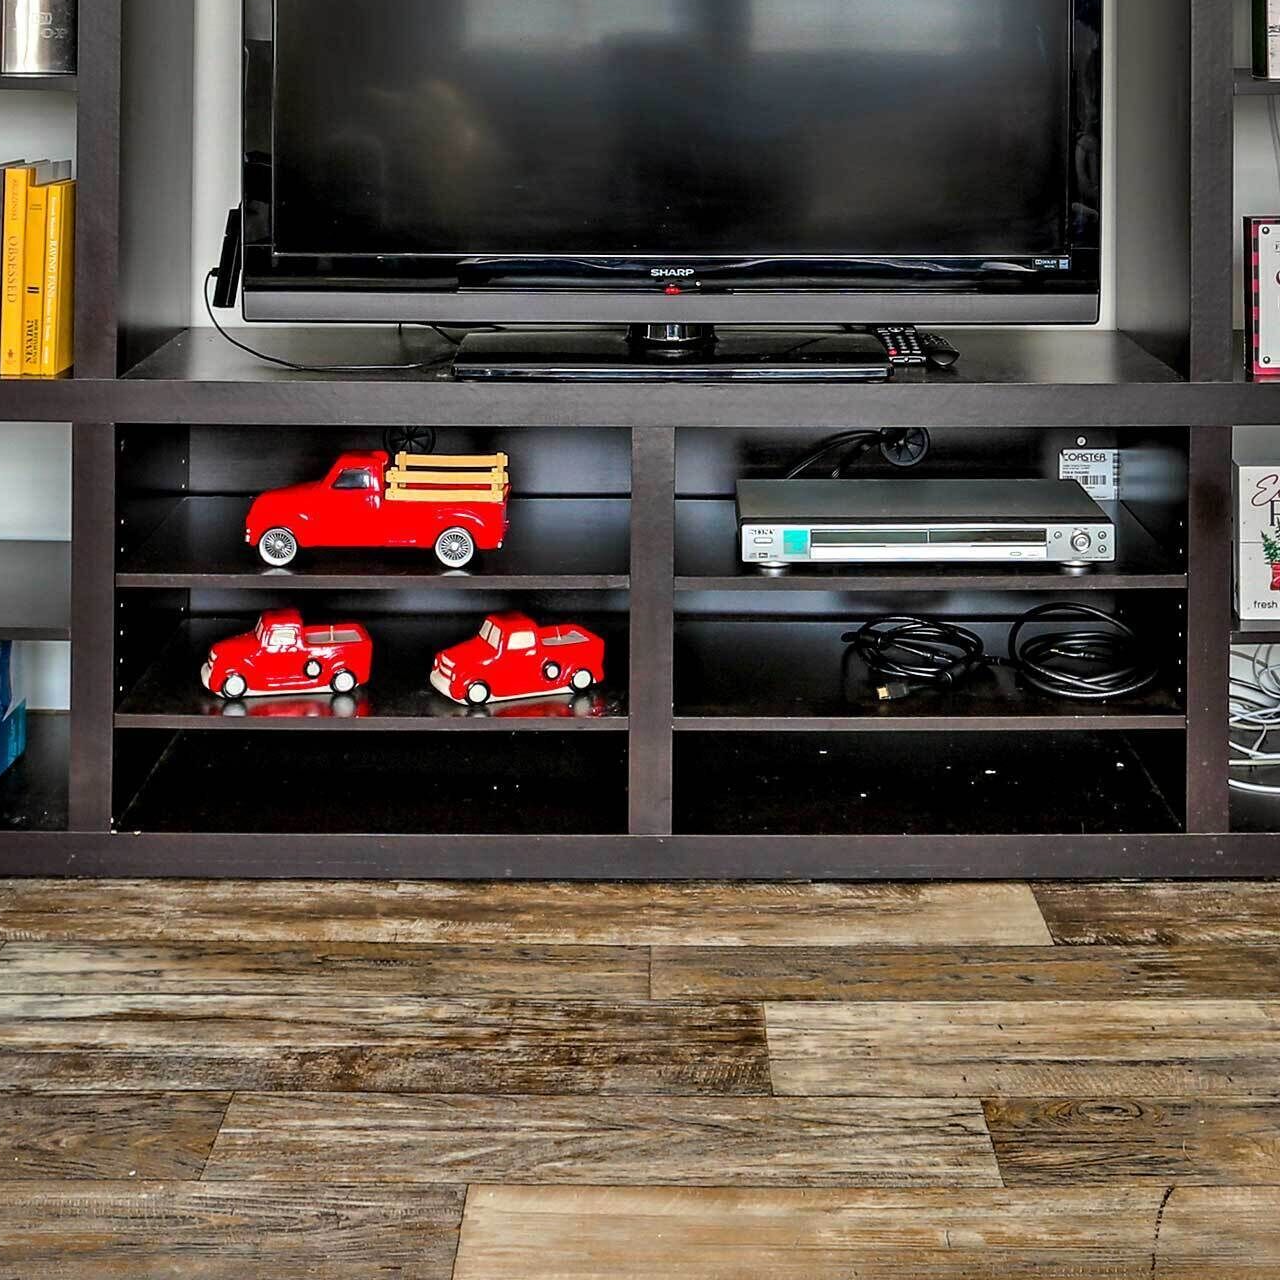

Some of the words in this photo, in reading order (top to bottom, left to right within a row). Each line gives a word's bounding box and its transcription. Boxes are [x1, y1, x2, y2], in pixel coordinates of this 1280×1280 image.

[7, 235, 17, 303] OBSESSED
[650, 268, 695, 277] SHARP
[1253, 600, 1278, 609] fresh
